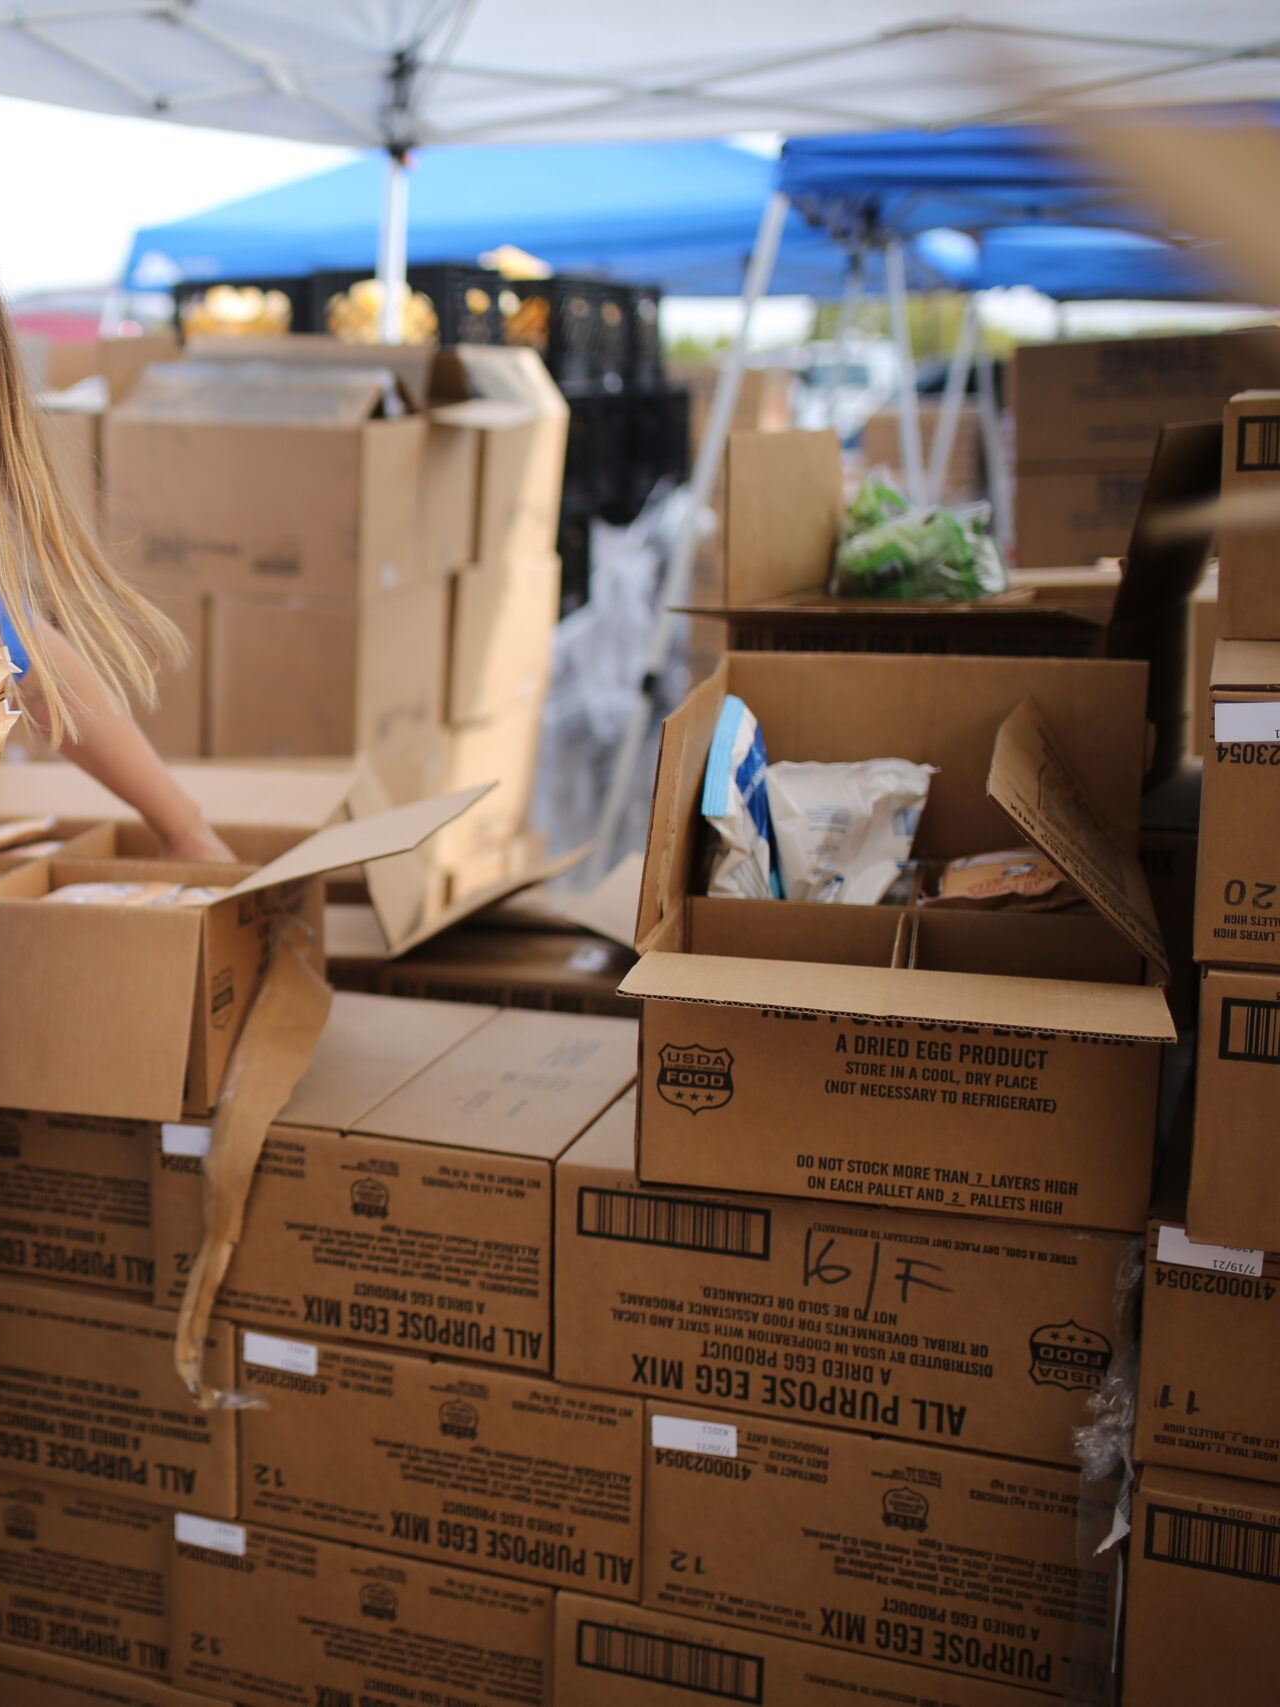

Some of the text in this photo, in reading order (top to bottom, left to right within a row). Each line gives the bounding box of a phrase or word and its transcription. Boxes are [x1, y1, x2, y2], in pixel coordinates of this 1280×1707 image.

[1224, 880, 1276, 910] 20
[1224, 914, 1247, 925] HIGH
[1213, 928, 1275, 942] LAYERS HIGH
[667, 1052, 725, 1066] USDA
[836, 1034, 1048, 1070] A DRIED EGG PRODUCT
[666, 1071, 724, 1087] FOOD
[846, 1061, 1038, 1090] STORE IN A COOL, DRY PLACE
[825, 1080, 1056, 1114] (NOT NECESSARY TO REFRIGERATE)
[796, 1154, 1078, 1196] DO NOT STOCK MORE THAN 7 LAYERS HIGH
[808, 1176, 1062, 1215] ON EACH PALLET AND 2 PALLETS HIGH
[813, 1223, 868, 1239] REFRIGERATE)
[871, 1230, 880, 1241] TO
[883, 1232, 929, 1247] NECESSARY
[933, 1238, 951, 1250] (NOT
[954, 1241, 980, 1253] PLACE
[984, 1245, 999, 1256] DRY
[1028, 1251, 1035, 1260] A
[1039, 1252, 1047, 1262] IN
[1050, 1253, 1077, 1266] STORE
[1213, 1260, 1256, 1274] 7/19/21
[1155, 1268, 1276, 1301] 4100023054
[354, 1283, 485, 1315] A DRIED EGG PRODUCT
[700, 1285, 773, 1309] EXCHANGED.
[778, 1296, 794, 1312] OR
[799, 1299, 830, 1317] SOLD
[834, 1304, 849, 1319] BE
[303, 1295, 542, 1359] ALL PURPOSE EGG MIX
[616, 1291, 989, 1357] OR TRIBAL GOVERNMENTS FOR FOOD ASSISTANCE PROGRAMS.
[873, 1310, 897, 1326] NOT
[610, 1308, 993, 1378] DISTRIBUTED BY USDA IN COOPERATION WITH STATE AND LOCAL
[700, 1340, 891, 1386] A DRIED EGG PRODUCT
[1040, 1347, 1102, 1366] FOOD
[1038, 1367, 1100, 1385] USDA
[632, 1355, 967, 1437] ALL PURPOSE EGG MIX
[1164, 1423, 1185, 1434] HIGH
[1188, 1426, 1225, 1441] PALLETS
[747, 1431, 769, 1447] DATE
[774, 1435, 828, 1457] PRODUCTION
[1153, 1434, 1176, 1446] HIGH
[1178, 1439, 1211, 1452] LAYERS
[1242, 1436, 1261, 1446] AND
[769, 1451, 829, 1470] DATE PACKED
[1225, 1447, 1249, 1458] THAN
[1252, 1450, 1278, 1462] MORE
[46, 1443, 147, 1485] PURPOSE
[656, 1449, 751, 1482] 4100023054
[154, 1464, 196, 1496] ALL
[253, 1463, 285, 1488] 12
[781, 1467, 828, 1484] CONTRACT
[390, 1510, 430, 1544] MIX
[438, 1520, 477, 1554] EGG
[485, 1530, 586, 1576] PURPOSE
[594, 1552, 633, 1586] ALL
[670, 1551, 706, 1576] 12
[881, 1597, 1039, 1642] A DRIED EGG PRODUCT
[819, 1606, 1051, 1683] PURPOSE EGG MIX
